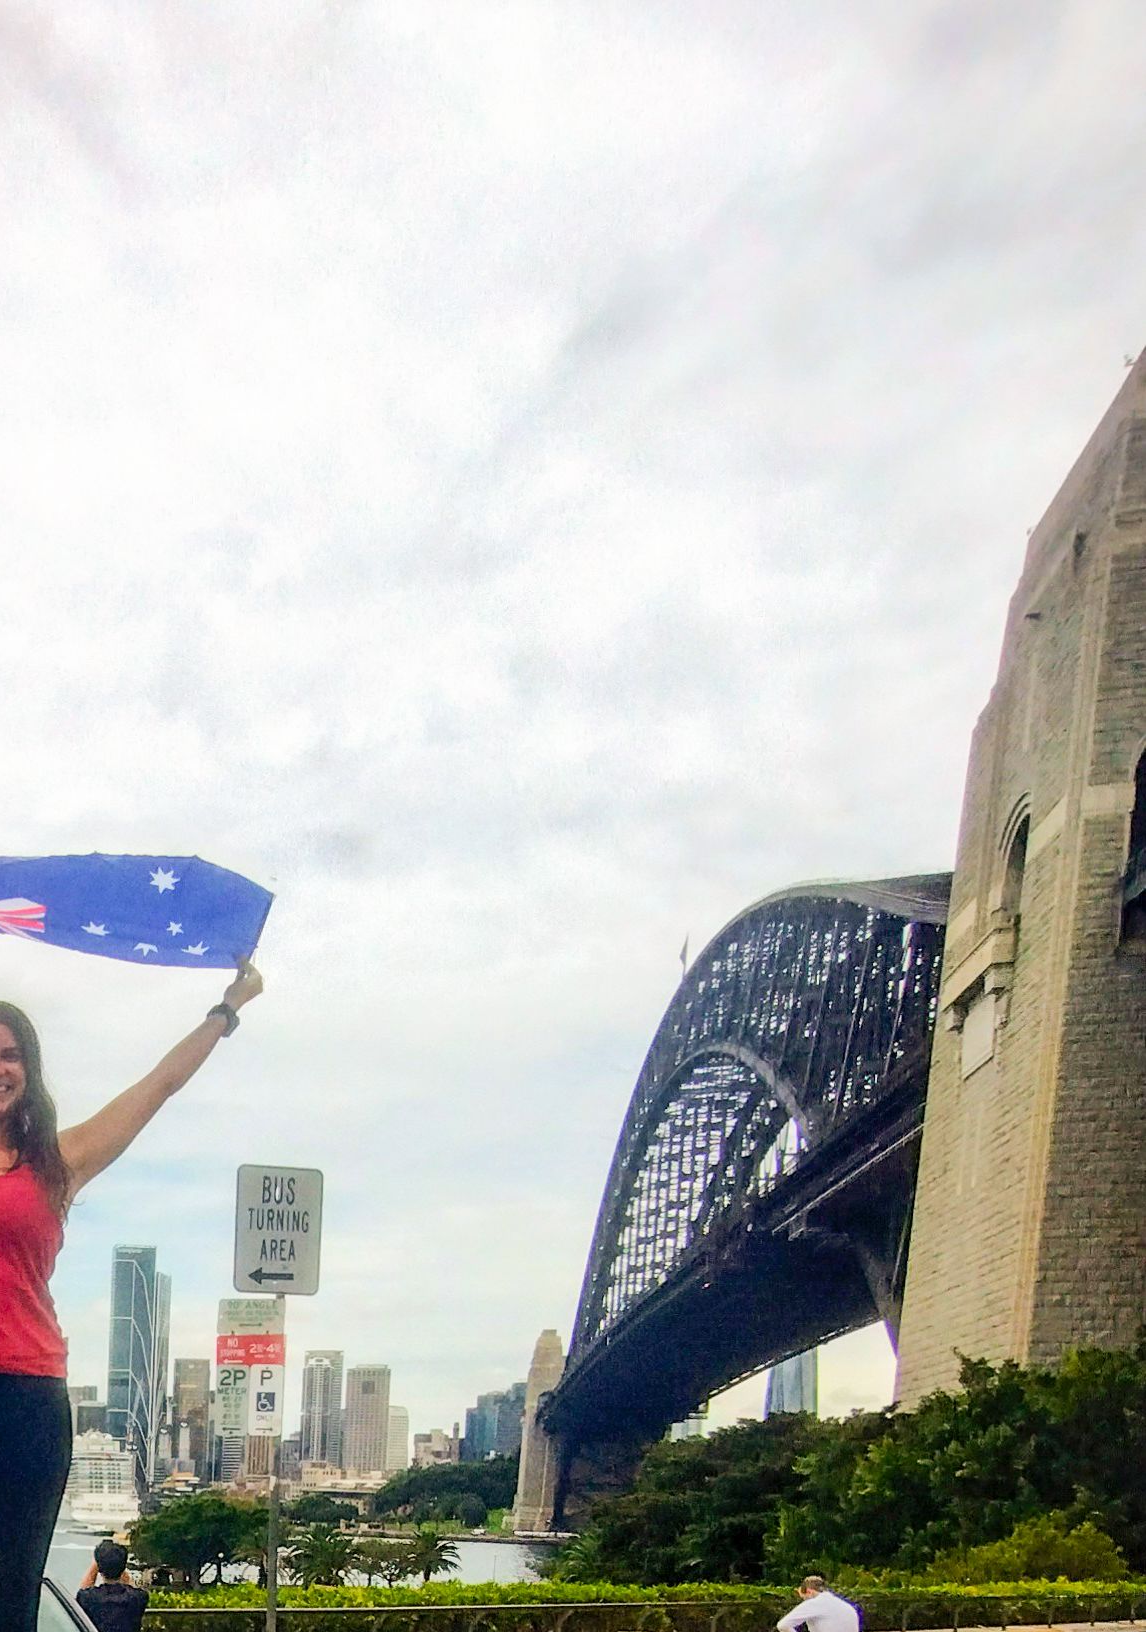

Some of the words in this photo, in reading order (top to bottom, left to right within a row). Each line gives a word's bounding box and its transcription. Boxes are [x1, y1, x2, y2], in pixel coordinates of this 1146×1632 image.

[262, 1175, 296, 1206] BUS
[248, 1208, 310, 1233] TURNING
[259, 1239, 296, 1262] AREA
[227, 1338, 239, 1348] NO
[219, 1369, 246, 1386] 2P
[260, 1370, 273, 1386] P
